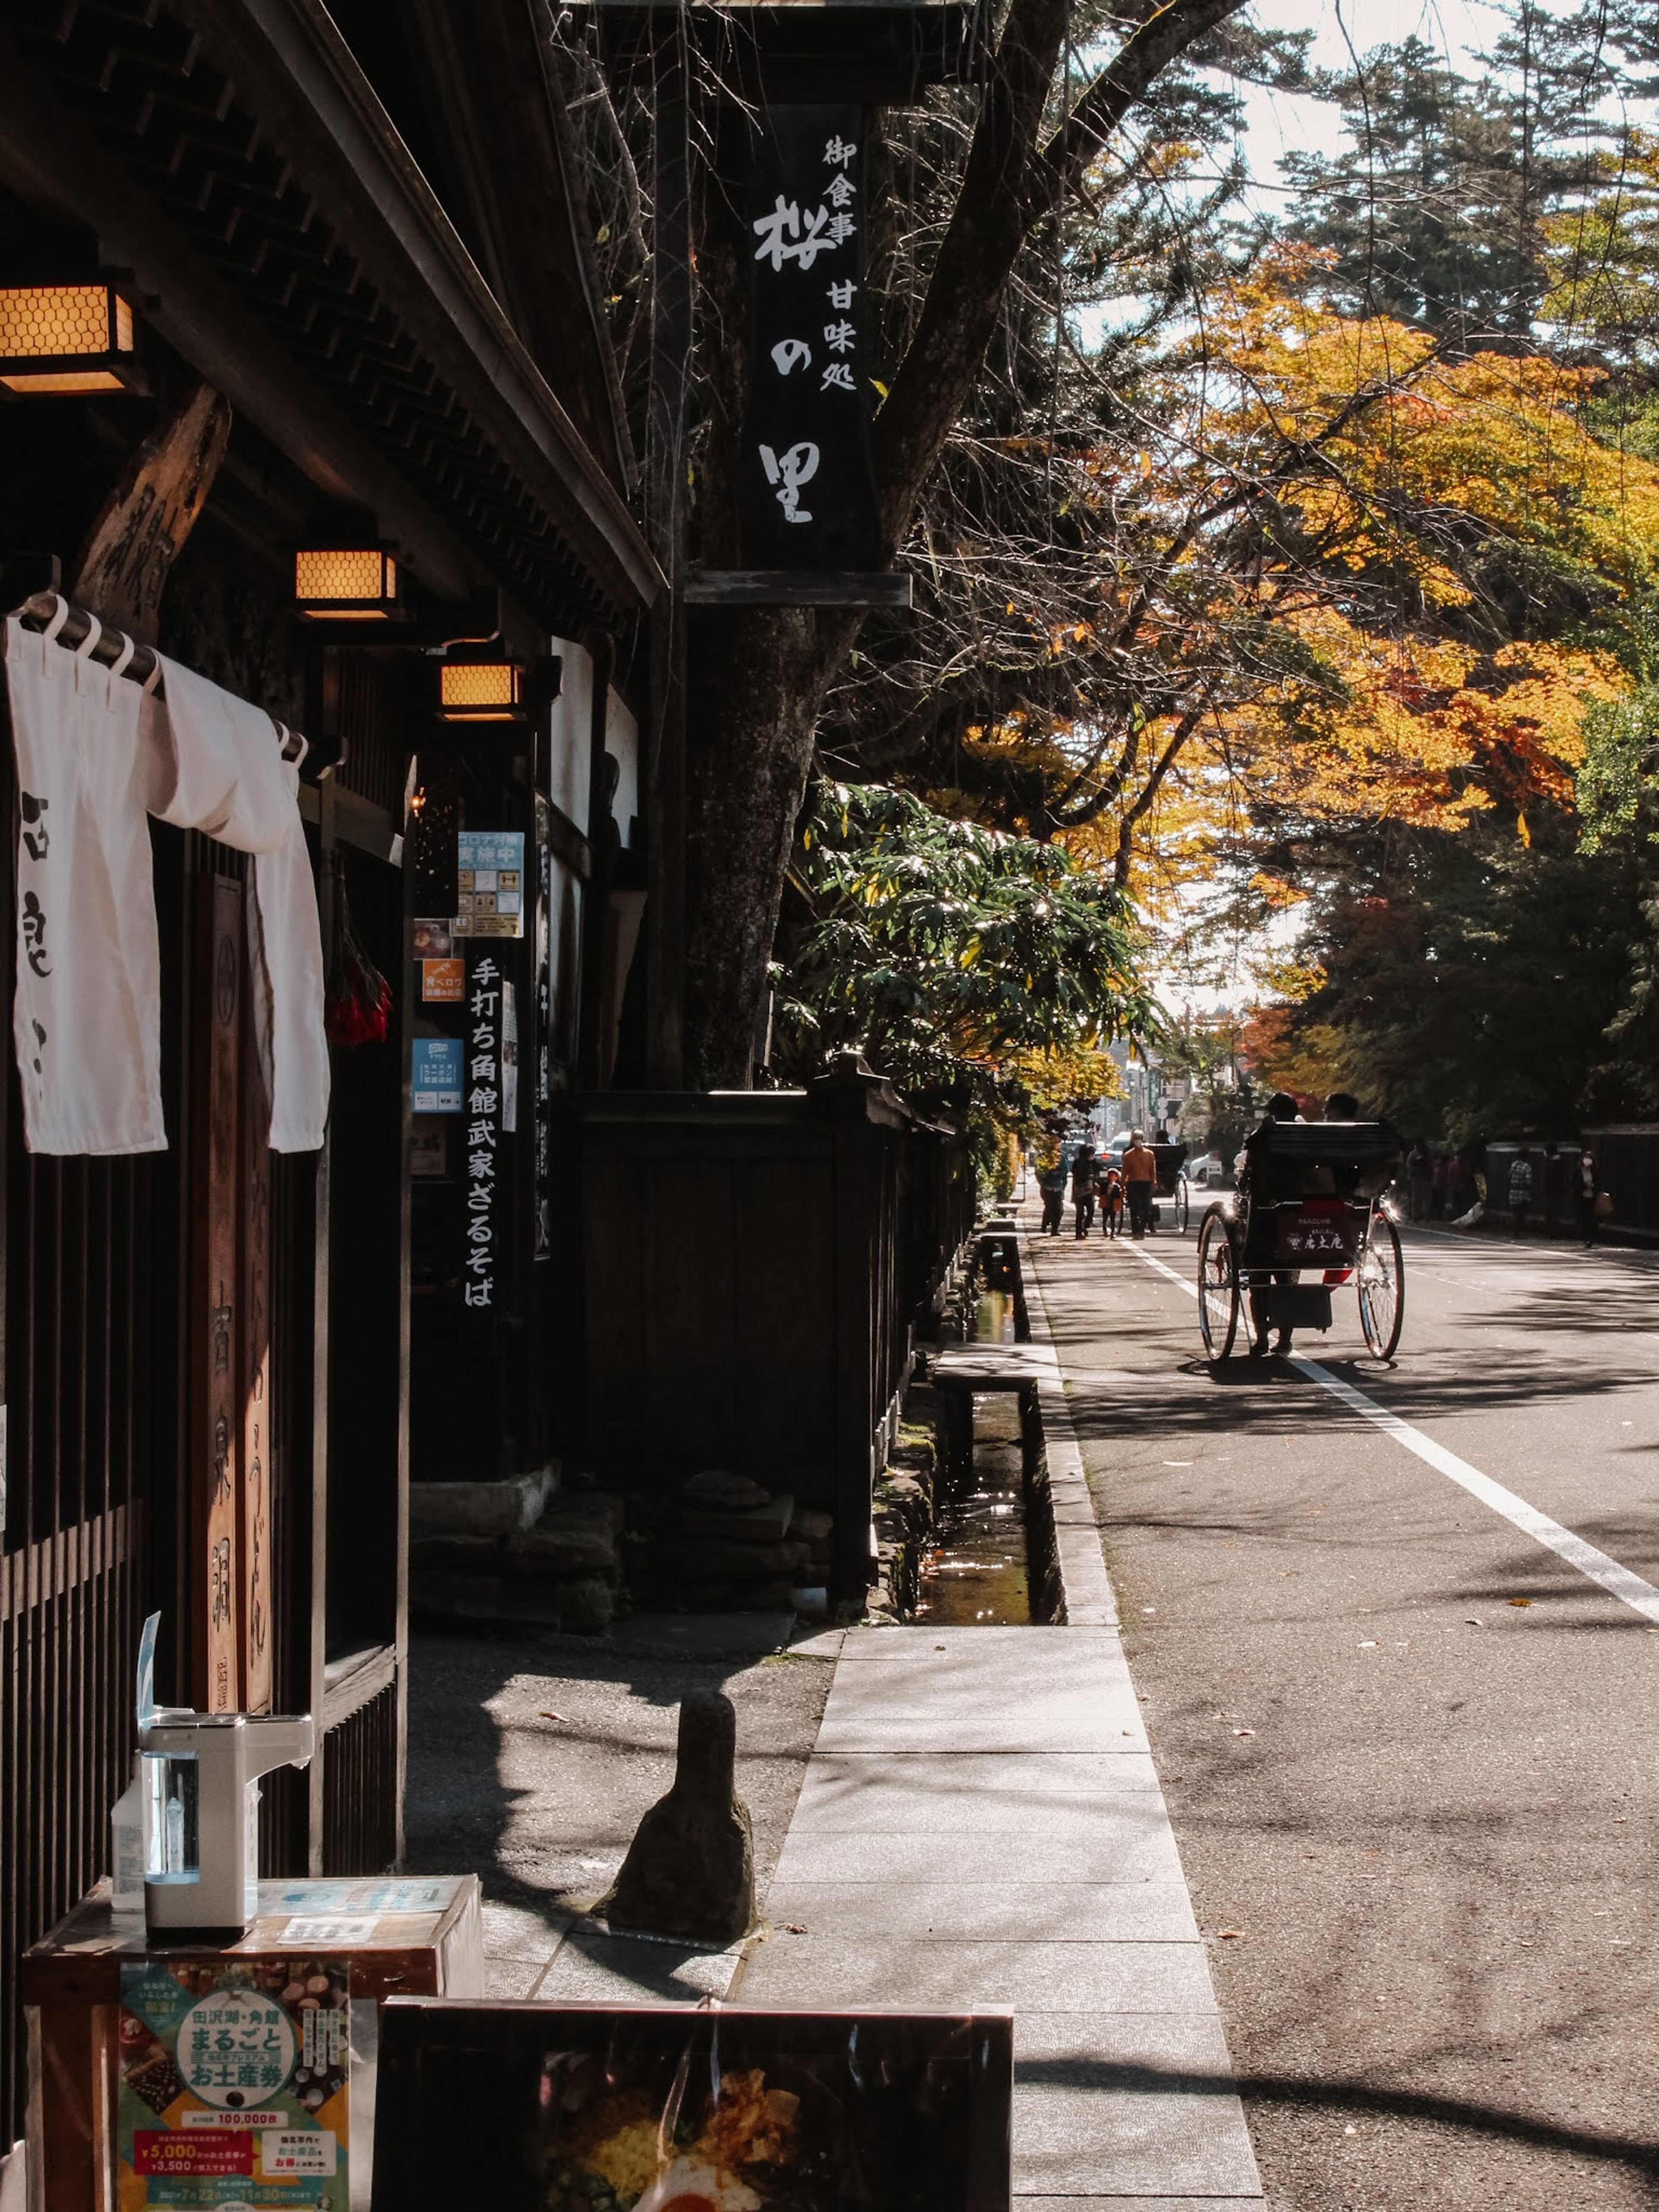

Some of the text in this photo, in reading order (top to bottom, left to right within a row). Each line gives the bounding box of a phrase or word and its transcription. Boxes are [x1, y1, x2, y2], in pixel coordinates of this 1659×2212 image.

[820, 134, 858, 391] 御食事 甘味処
[753, 194, 837, 524] 桜の里
[465, 957, 500, 1307] 手打ち角館武家ざるそば
[191, 2064, 282, 2087] お土産券
[192, 2028, 281, 2050] まるごと
[193, 2009, 279, 2024] 田沢湖・角館
